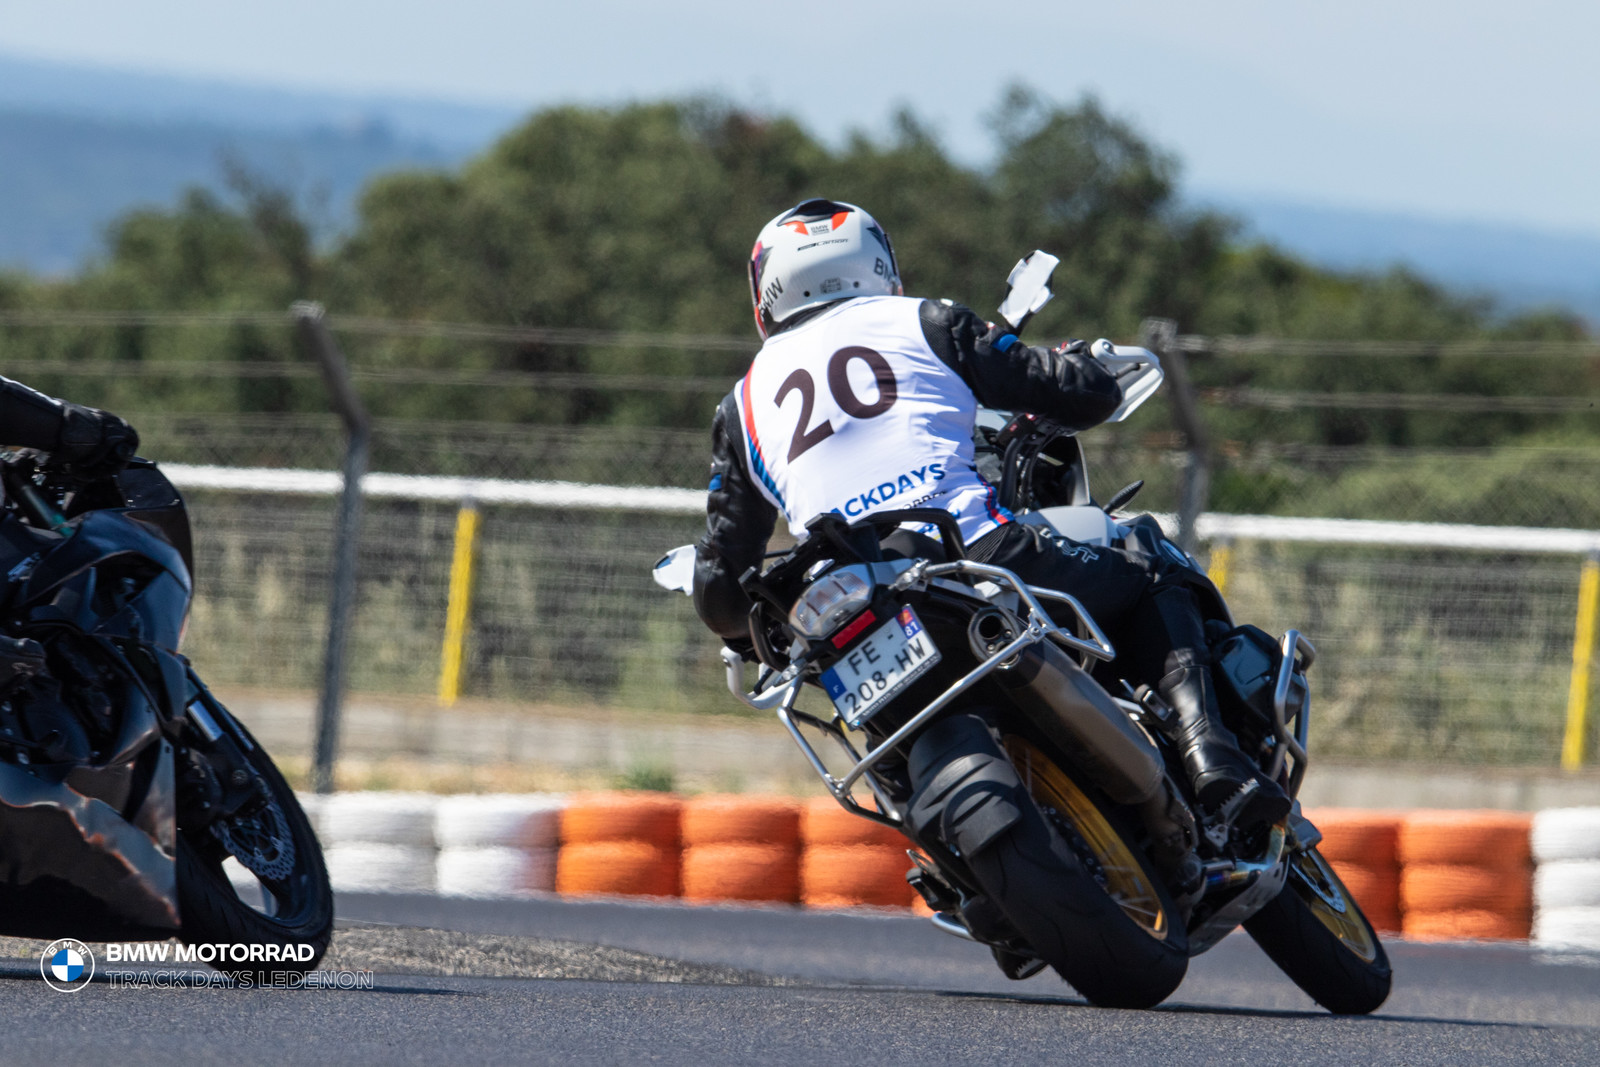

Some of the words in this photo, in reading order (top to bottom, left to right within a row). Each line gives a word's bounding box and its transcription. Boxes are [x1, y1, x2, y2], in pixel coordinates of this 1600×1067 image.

[774, 345, 898, 464] 20
[905, 621, 920, 636] 81
[844, 637, 926, 714] 208-HW
